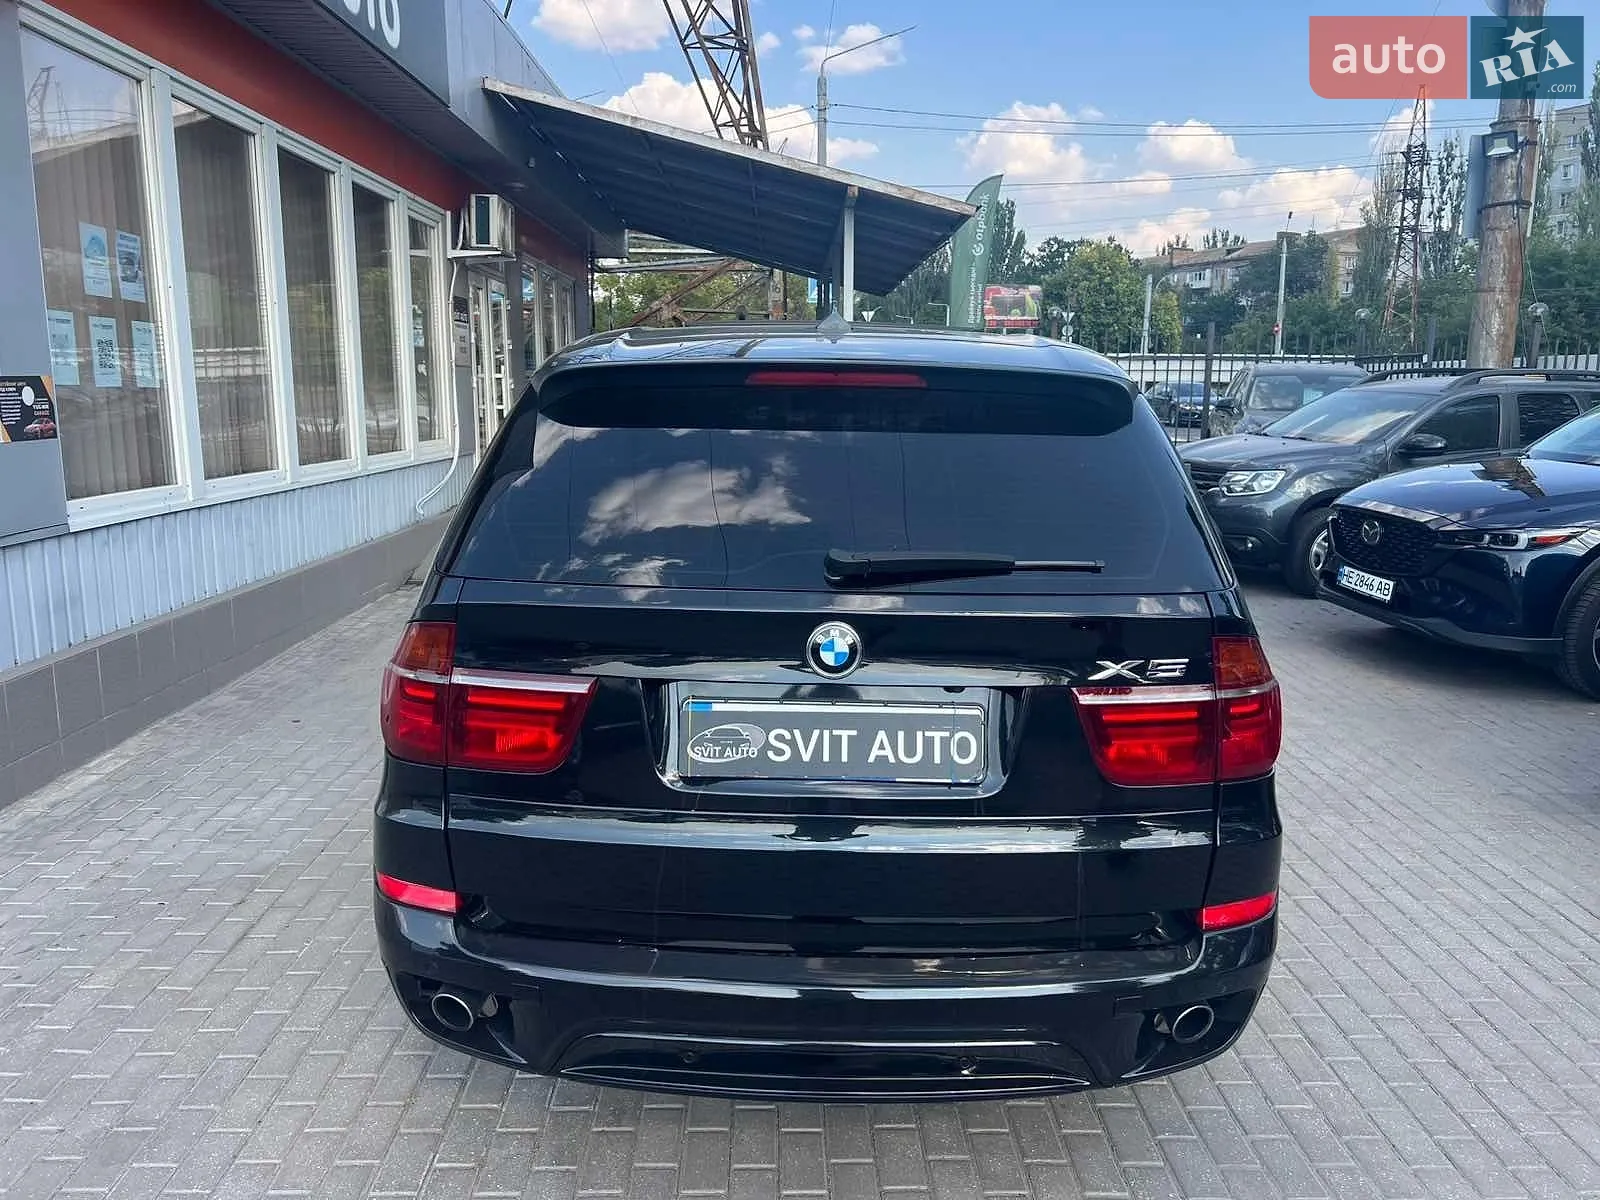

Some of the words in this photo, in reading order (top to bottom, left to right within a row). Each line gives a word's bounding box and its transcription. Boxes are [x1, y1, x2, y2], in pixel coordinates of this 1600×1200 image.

[1354, 573, 1375, 591] 2846
[1376, 581, 1391, 596] AB
[815, 629, 855, 645] BMW
[1087, 658, 1190, 683] X5
[693, 745, 722, 758] SVIT
[723, 745, 758, 759] AUTO
[766, 728, 857, 763] SVIT
[867, 730, 978, 766] AUTO
